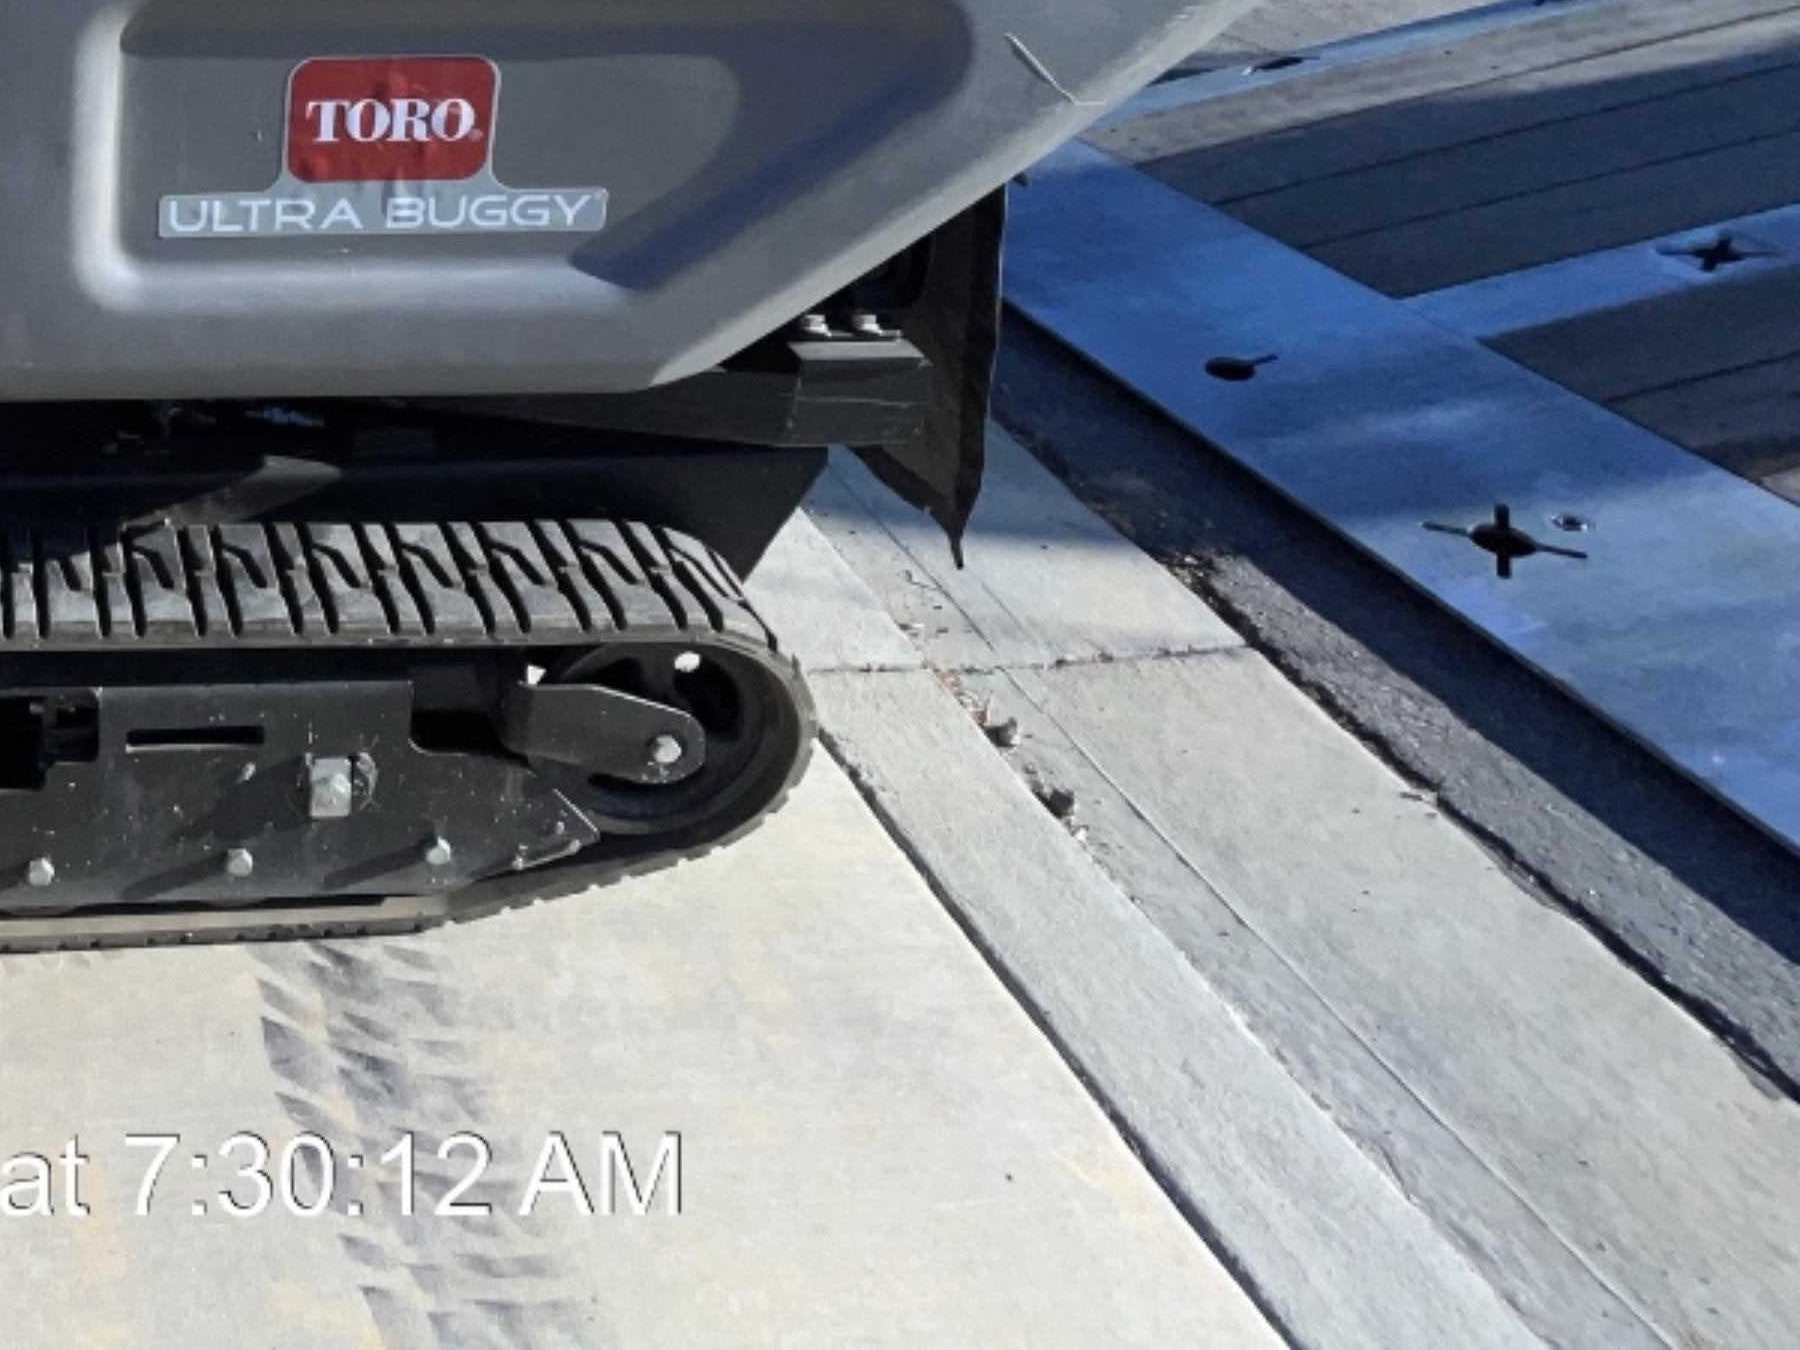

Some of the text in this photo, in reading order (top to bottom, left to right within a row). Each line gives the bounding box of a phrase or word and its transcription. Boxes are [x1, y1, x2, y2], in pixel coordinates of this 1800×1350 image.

[306, 97, 476, 143] TORO
[168, 193, 592, 233] ULTRA BUGGY
